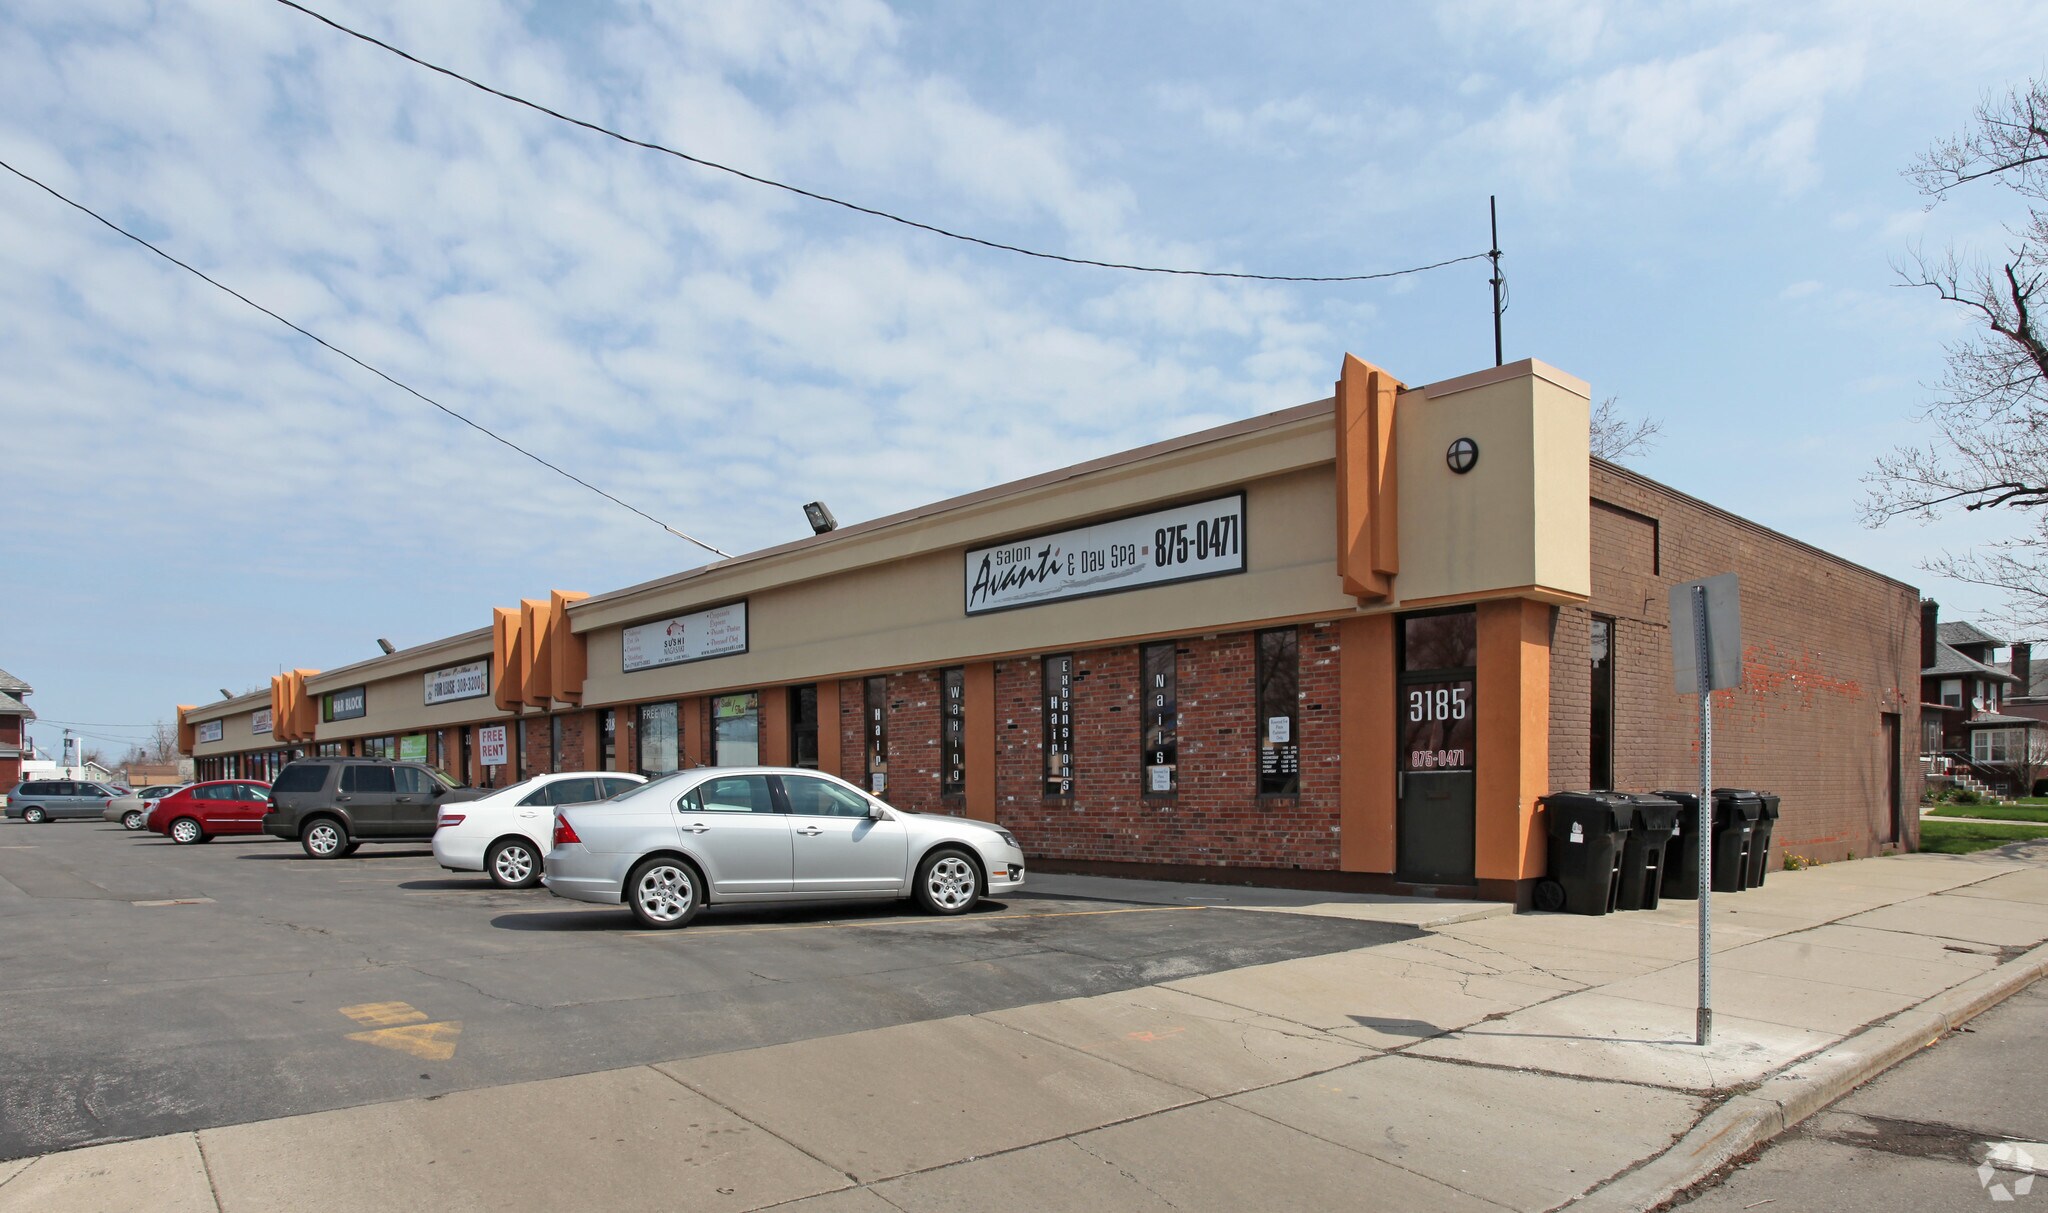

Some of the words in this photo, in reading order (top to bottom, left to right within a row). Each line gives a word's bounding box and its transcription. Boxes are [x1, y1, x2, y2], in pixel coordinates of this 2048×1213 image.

[969, 544, 1063, 607] Avanti
[1081, 549, 1105, 573] Day
[1111, 544, 1136, 569] Spa
[1154, 514, 1238, 567] 875-0471
[996, 546, 1031, 566] Salon
[663, 637, 685, 648] SUSHI
[443, 680, 455, 695] LEASE
[345, 695, 362, 711] BLOCK
[1410, 688, 1466, 722] 3185
[642, 708, 659, 719] FREE
[1156, 674, 1164, 764] Nails
[950, 686, 960, 781] Waxing
[1050, 696, 1058, 756] Hair
[482, 729, 503, 742] FREE
[482, 744, 504, 757] RENT
[1412, 750, 1465, 767] 875-0471
